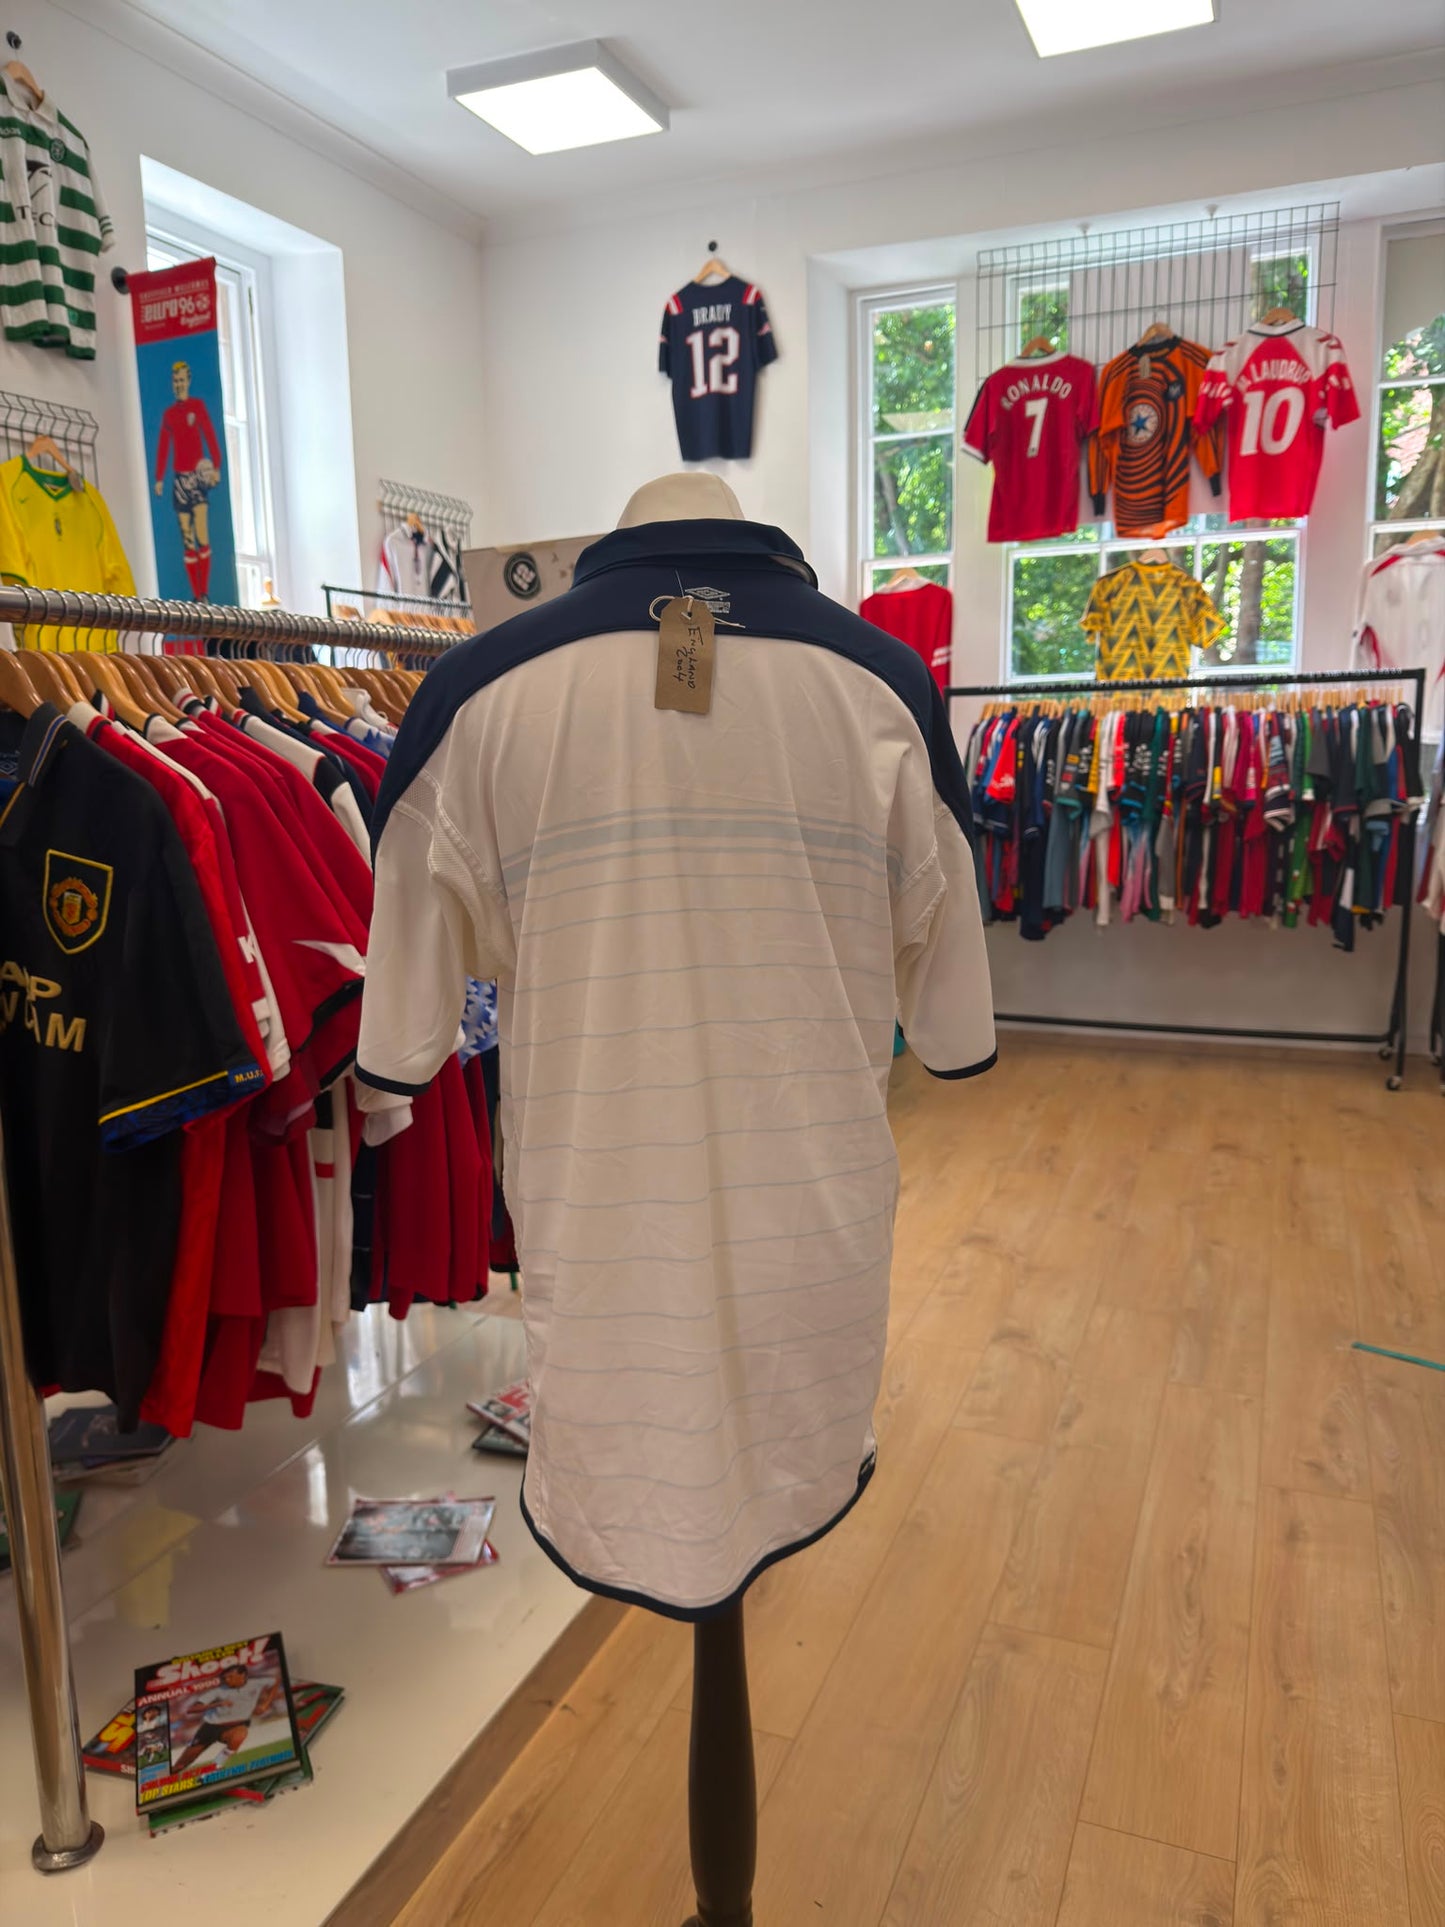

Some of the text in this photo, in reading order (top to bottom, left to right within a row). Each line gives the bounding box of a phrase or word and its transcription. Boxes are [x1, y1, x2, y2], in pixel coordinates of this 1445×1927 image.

[692, 304, 732, 326] BRADY
[685, 326, 740, 399] 12
[1001, 372, 1073, 411] RONALDO
[1025, 396, 1049, 458] 7
[1240, 386, 1306, 457] 10
[156, 1637, 270, 1686] Shoot!
[138, 1685, 190, 1707] ANNUAL
[140, 1789, 160, 1804] TOP
